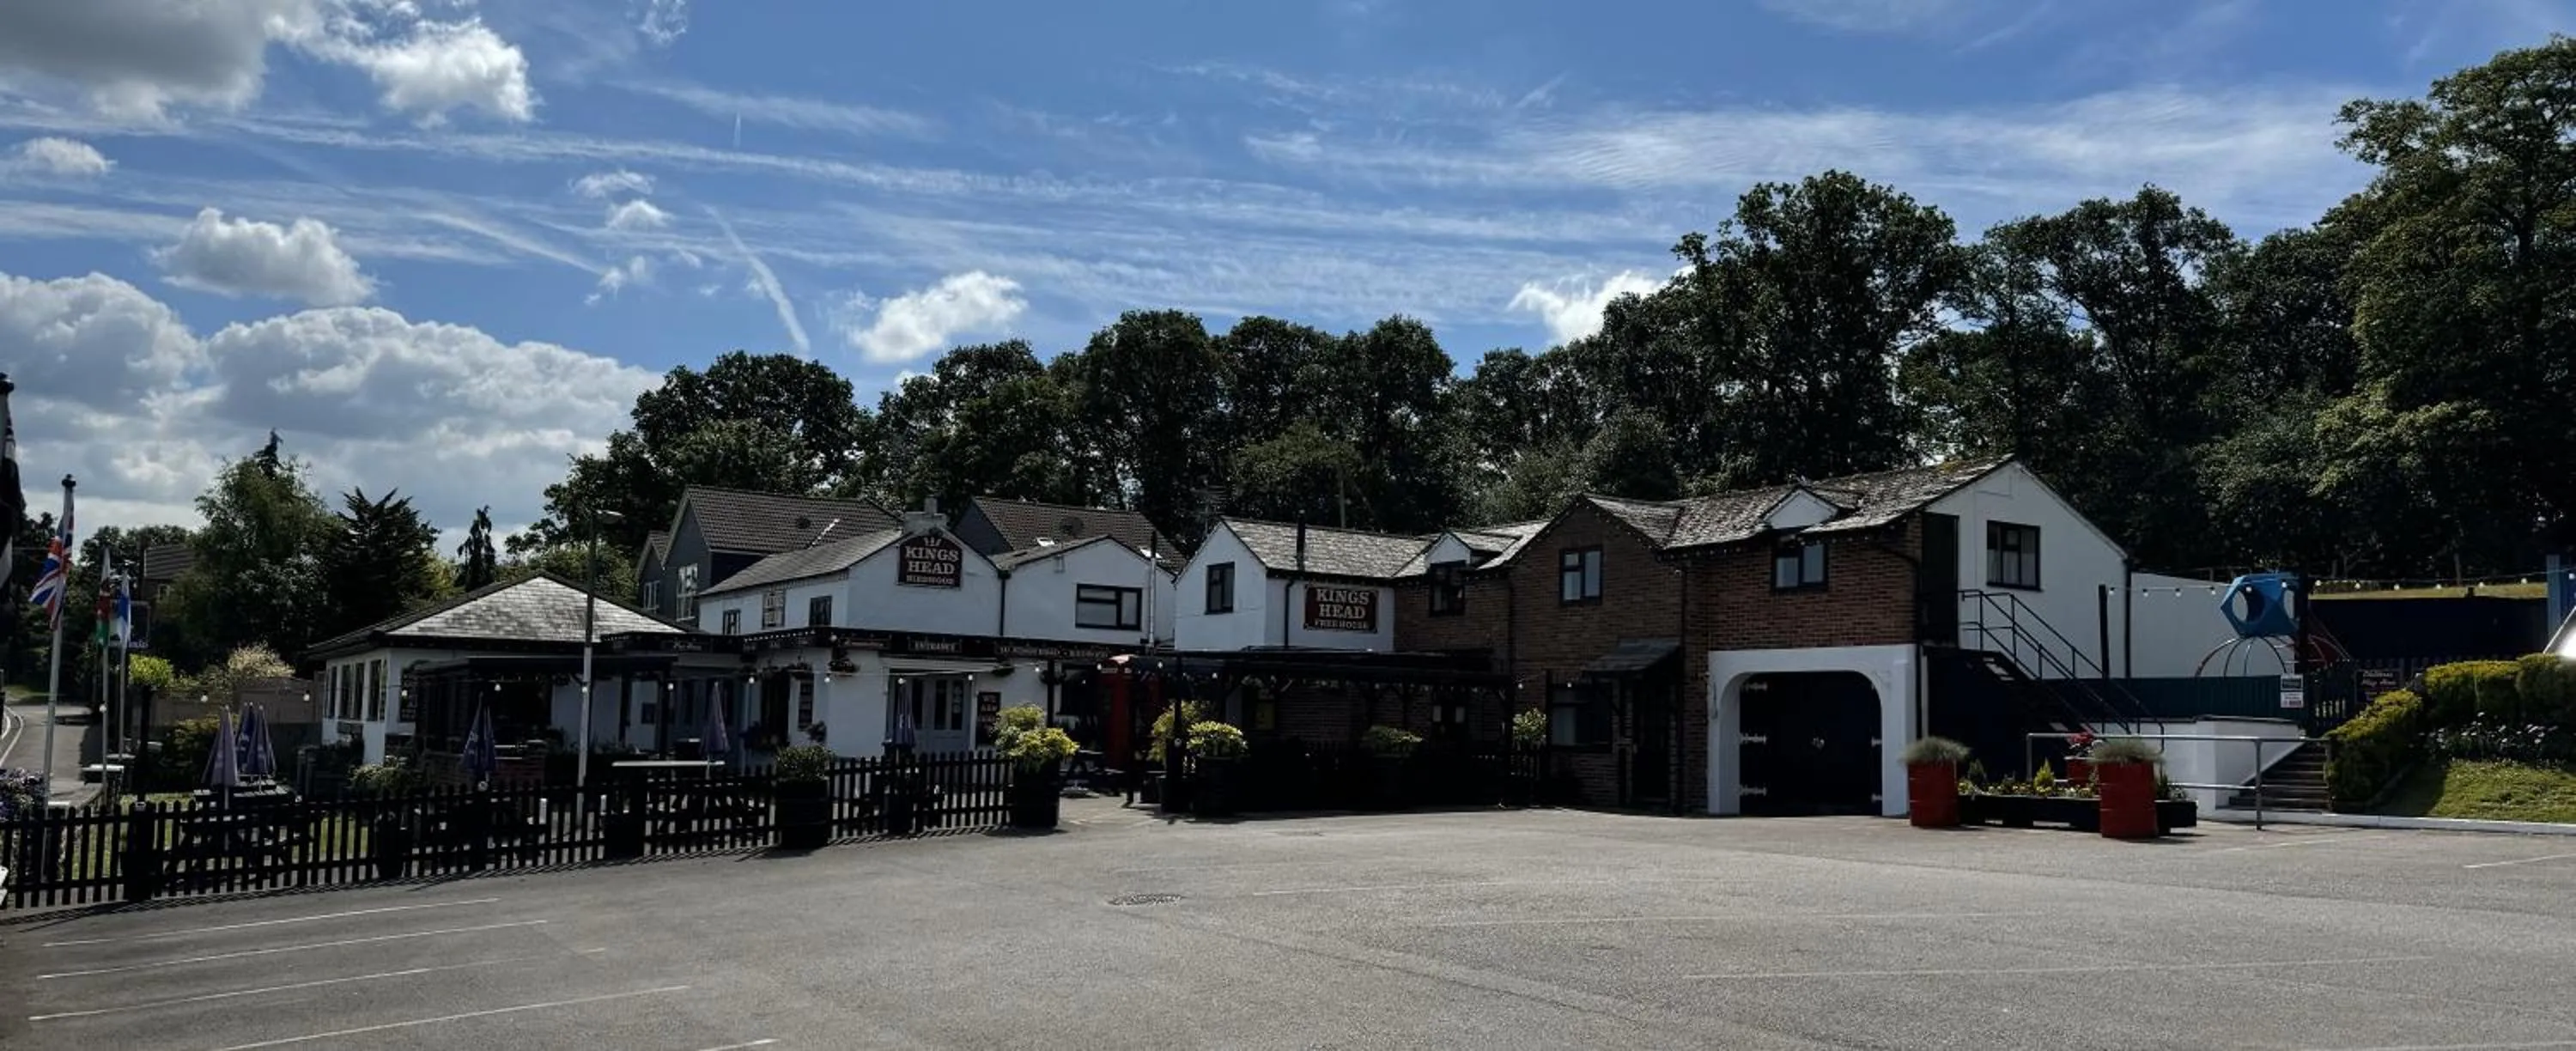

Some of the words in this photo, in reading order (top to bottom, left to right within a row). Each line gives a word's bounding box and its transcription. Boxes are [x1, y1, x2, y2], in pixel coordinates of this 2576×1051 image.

[905, 546, 959, 562] KINGS
[908, 561, 955, 574] HEAD
[1315, 588, 1370, 605] KINGS
[1318, 604, 1367, 619] HEAD
